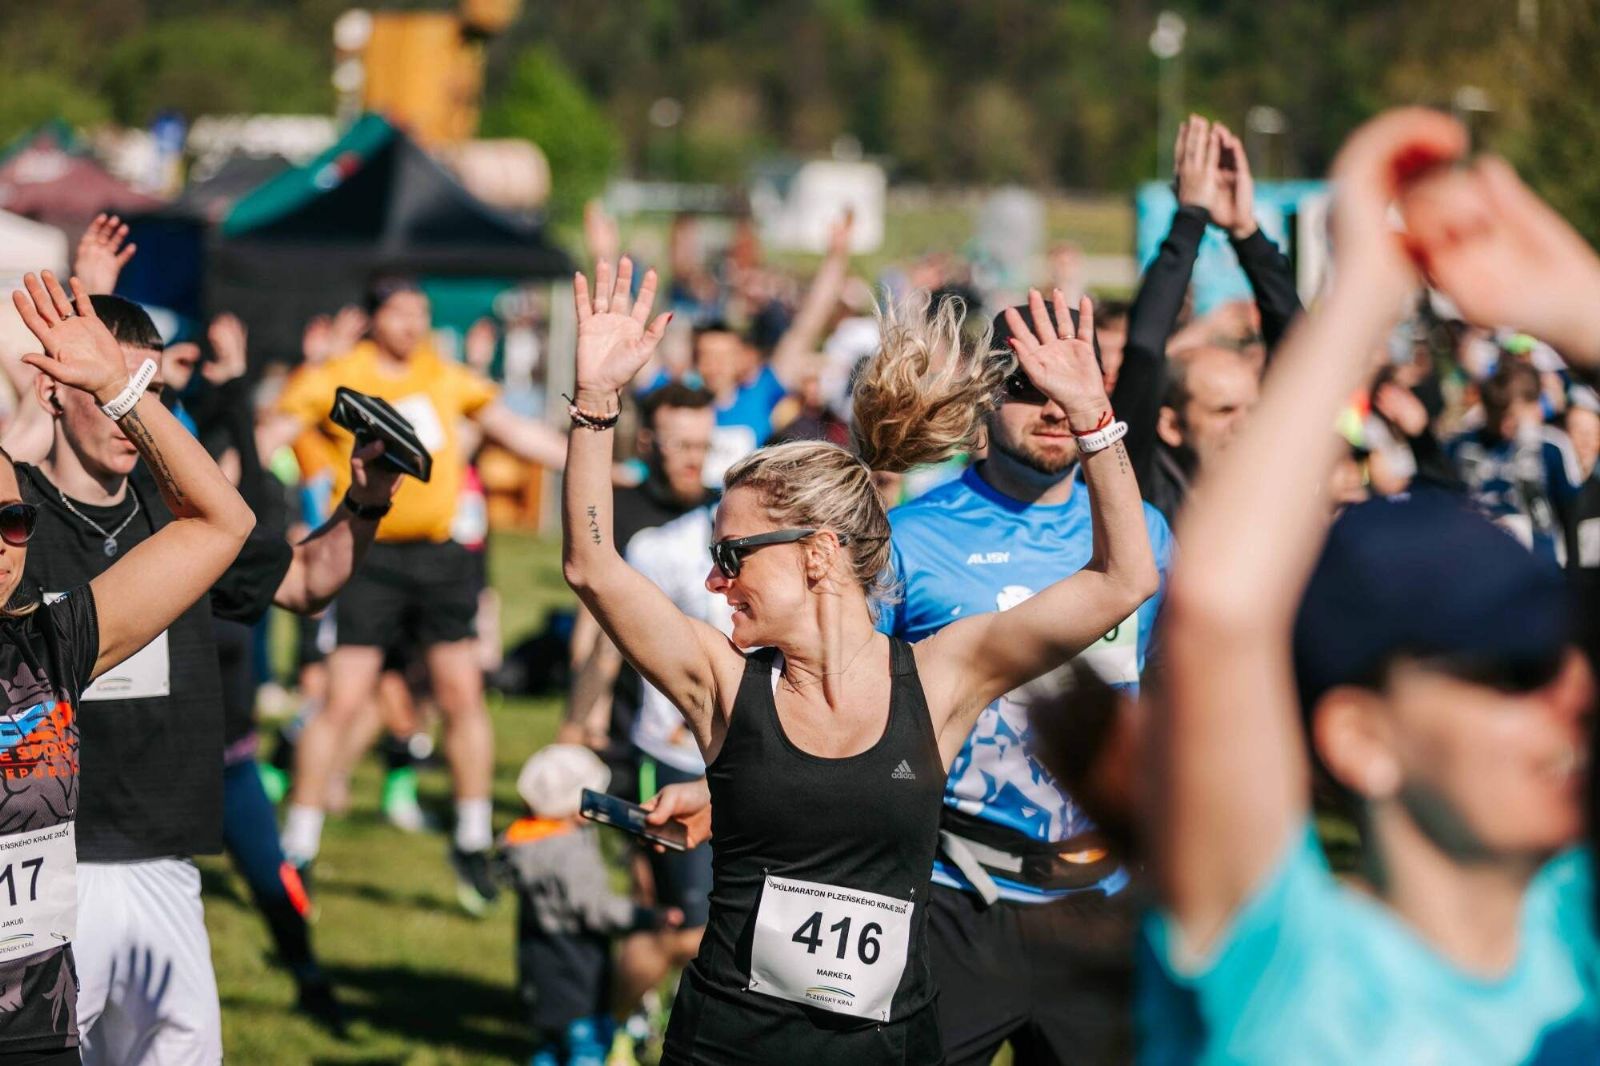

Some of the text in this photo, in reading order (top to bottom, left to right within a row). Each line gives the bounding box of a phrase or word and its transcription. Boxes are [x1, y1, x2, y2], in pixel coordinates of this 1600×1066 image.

[891, 772, 916, 780] adidas
[33, 832, 54, 844] KRAJE
[827, 891, 876, 908] PLZEŇSKÉHO
[876, 901, 896, 913] KRAJE
[1, 917, 24, 928] JAKUB
[791, 911, 883, 965] 416
